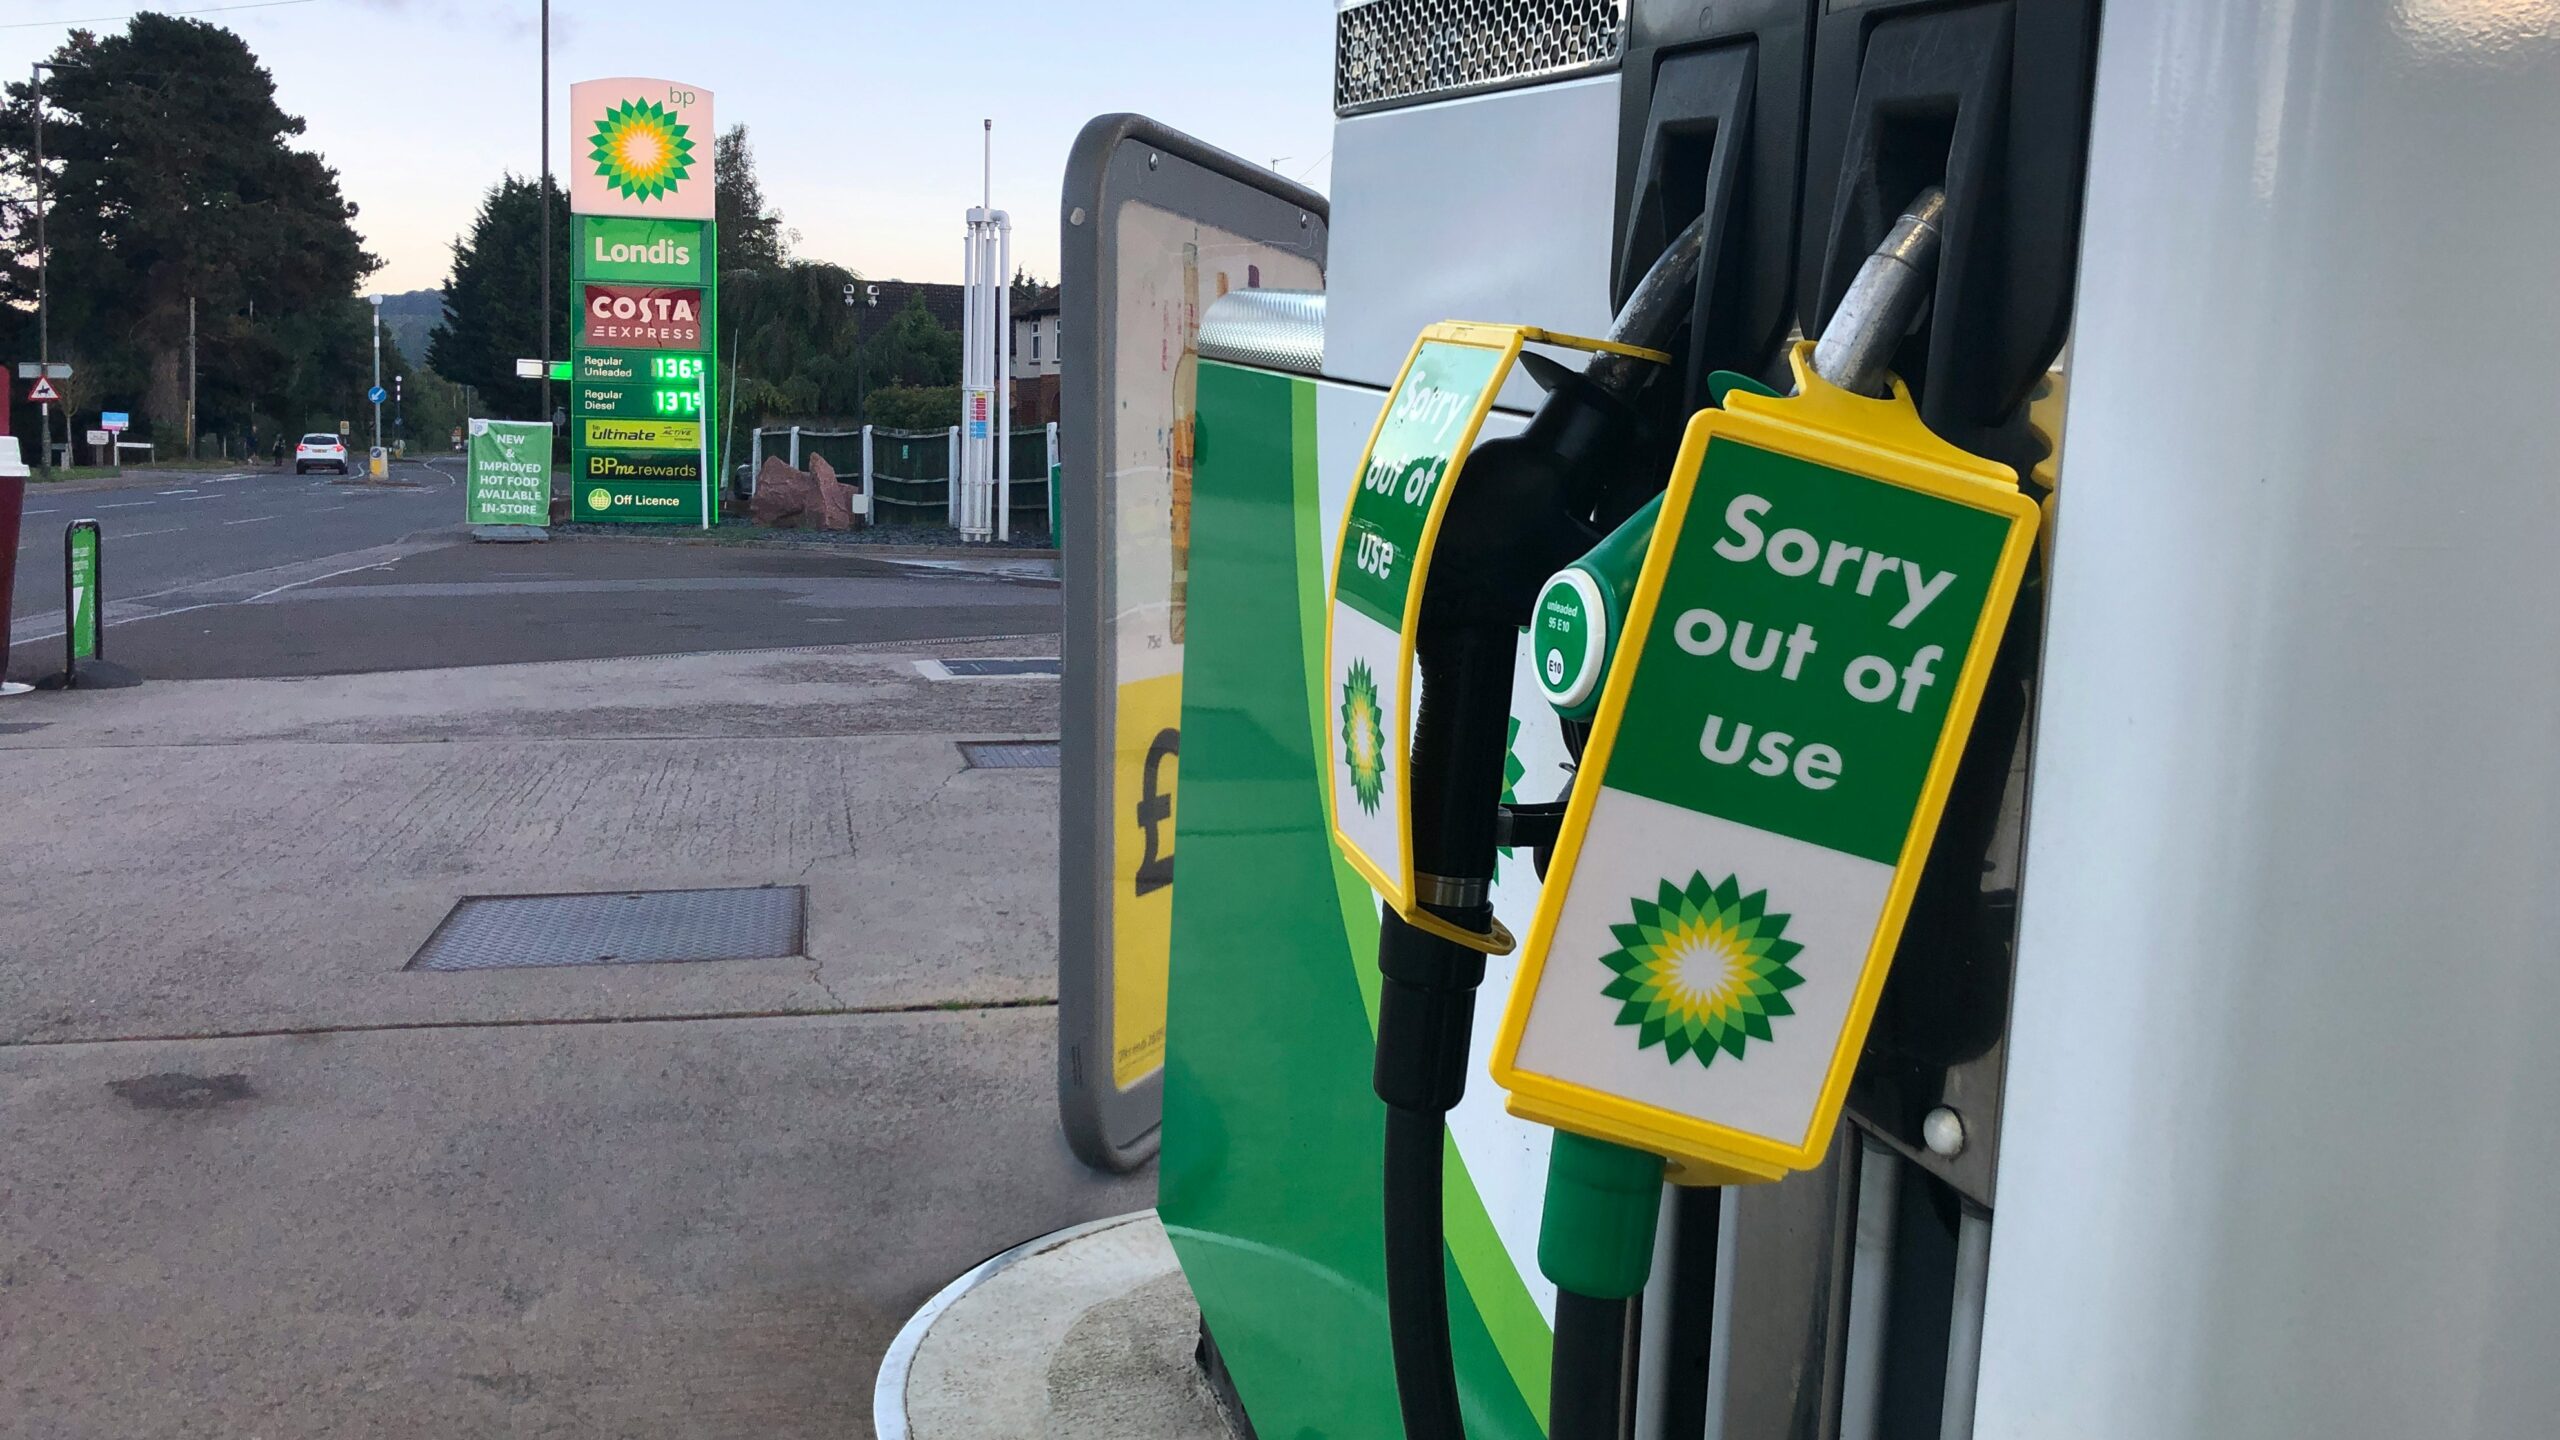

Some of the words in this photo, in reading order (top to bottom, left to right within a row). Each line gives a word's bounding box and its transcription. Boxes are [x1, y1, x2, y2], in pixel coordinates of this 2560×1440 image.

[670, 87, 695, 108] bp
[595, 237, 690, 265] Londis
[592, 296, 694, 323] COSTA
[608, 326, 694, 340] EXPRESS
[584, 356, 622, 366] Regular
[584, 368, 632, 377] Unleaded
[584, 390, 622, 400] Regular
[584, 401, 615, 410] Diesel
[1397, 371, 1469, 444] Sorry
[496, 434, 525, 445] NEW
[592, 428, 655, 441] ultimate
[505, 449, 515, 458] &
[479, 461, 542, 473] IMPROVED
[638, 464, 697, 477] rewards
[480, 475, 504, 485] HOT
[507, 477, 540, 487] FOOD
[1365, 452, 1409, 496] out
[1404, 451, 1446, 507] of
[477, 489, 542, 501] AVAILABLE
[614, 494, 632, 505] Off
[635, 495, 680, 506] Licence
[481, 503, 537, 515] IN-STORE
[1357, 532, 1393, 580] use
[1712, 493, 1958, 630] Sorry
[1547, 600, 1579, 617] unleaded
[1548, 617, 1557, 629] 95
[1557, 619, 1570, 633] E10
[1673, 608, 1818, 681] out
[1843, 644, 1944, 713] of
[1548, 660, 1562, 675] E10
[1699, 714, 1843, 790] use
